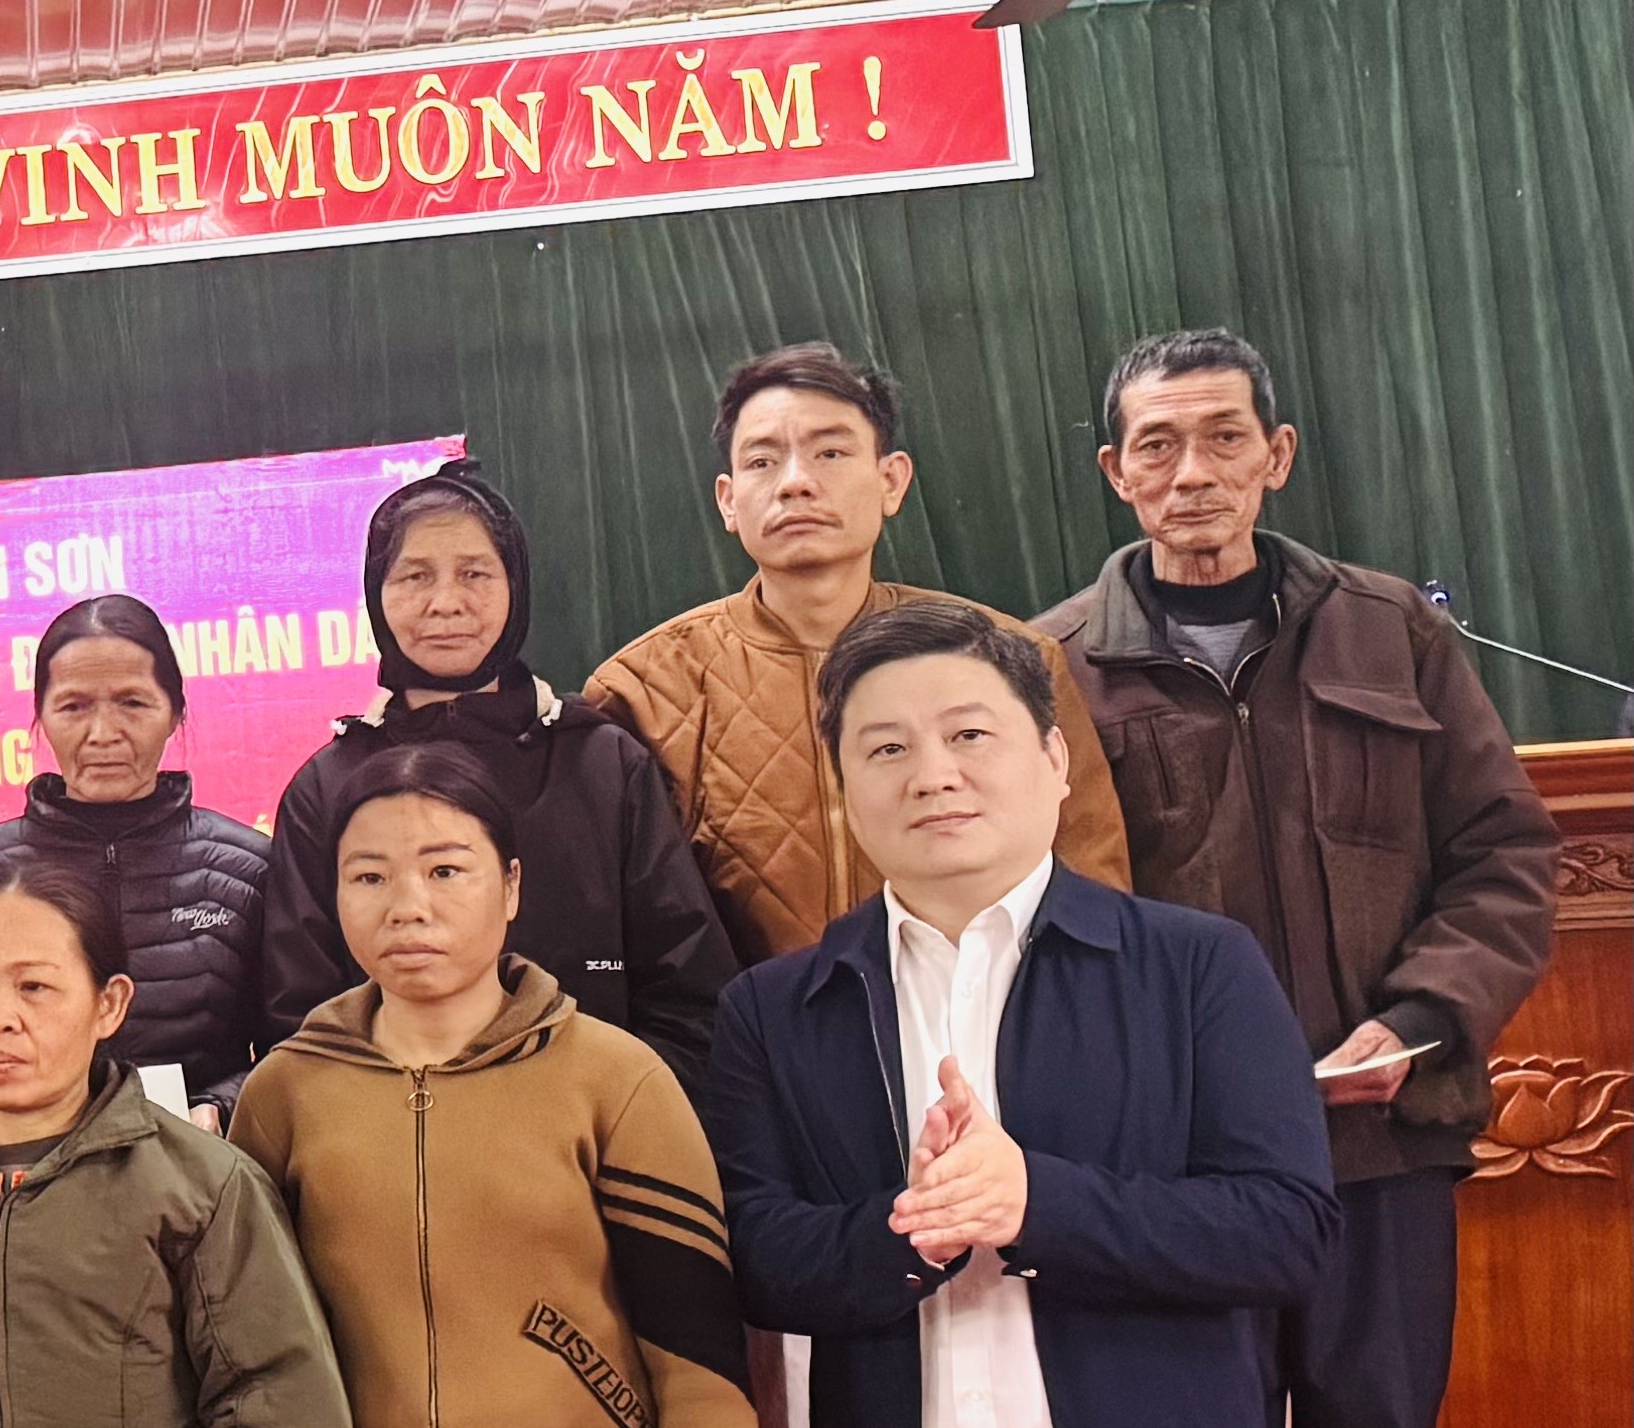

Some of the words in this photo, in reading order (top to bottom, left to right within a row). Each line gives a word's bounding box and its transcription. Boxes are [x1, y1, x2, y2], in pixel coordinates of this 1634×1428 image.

[236, 73, 545, 204] MUÔN
[580, 47, 822, 169] NĂM
[862, 55, 887, 141] !
[23, 533, 128, 598] SƠN
